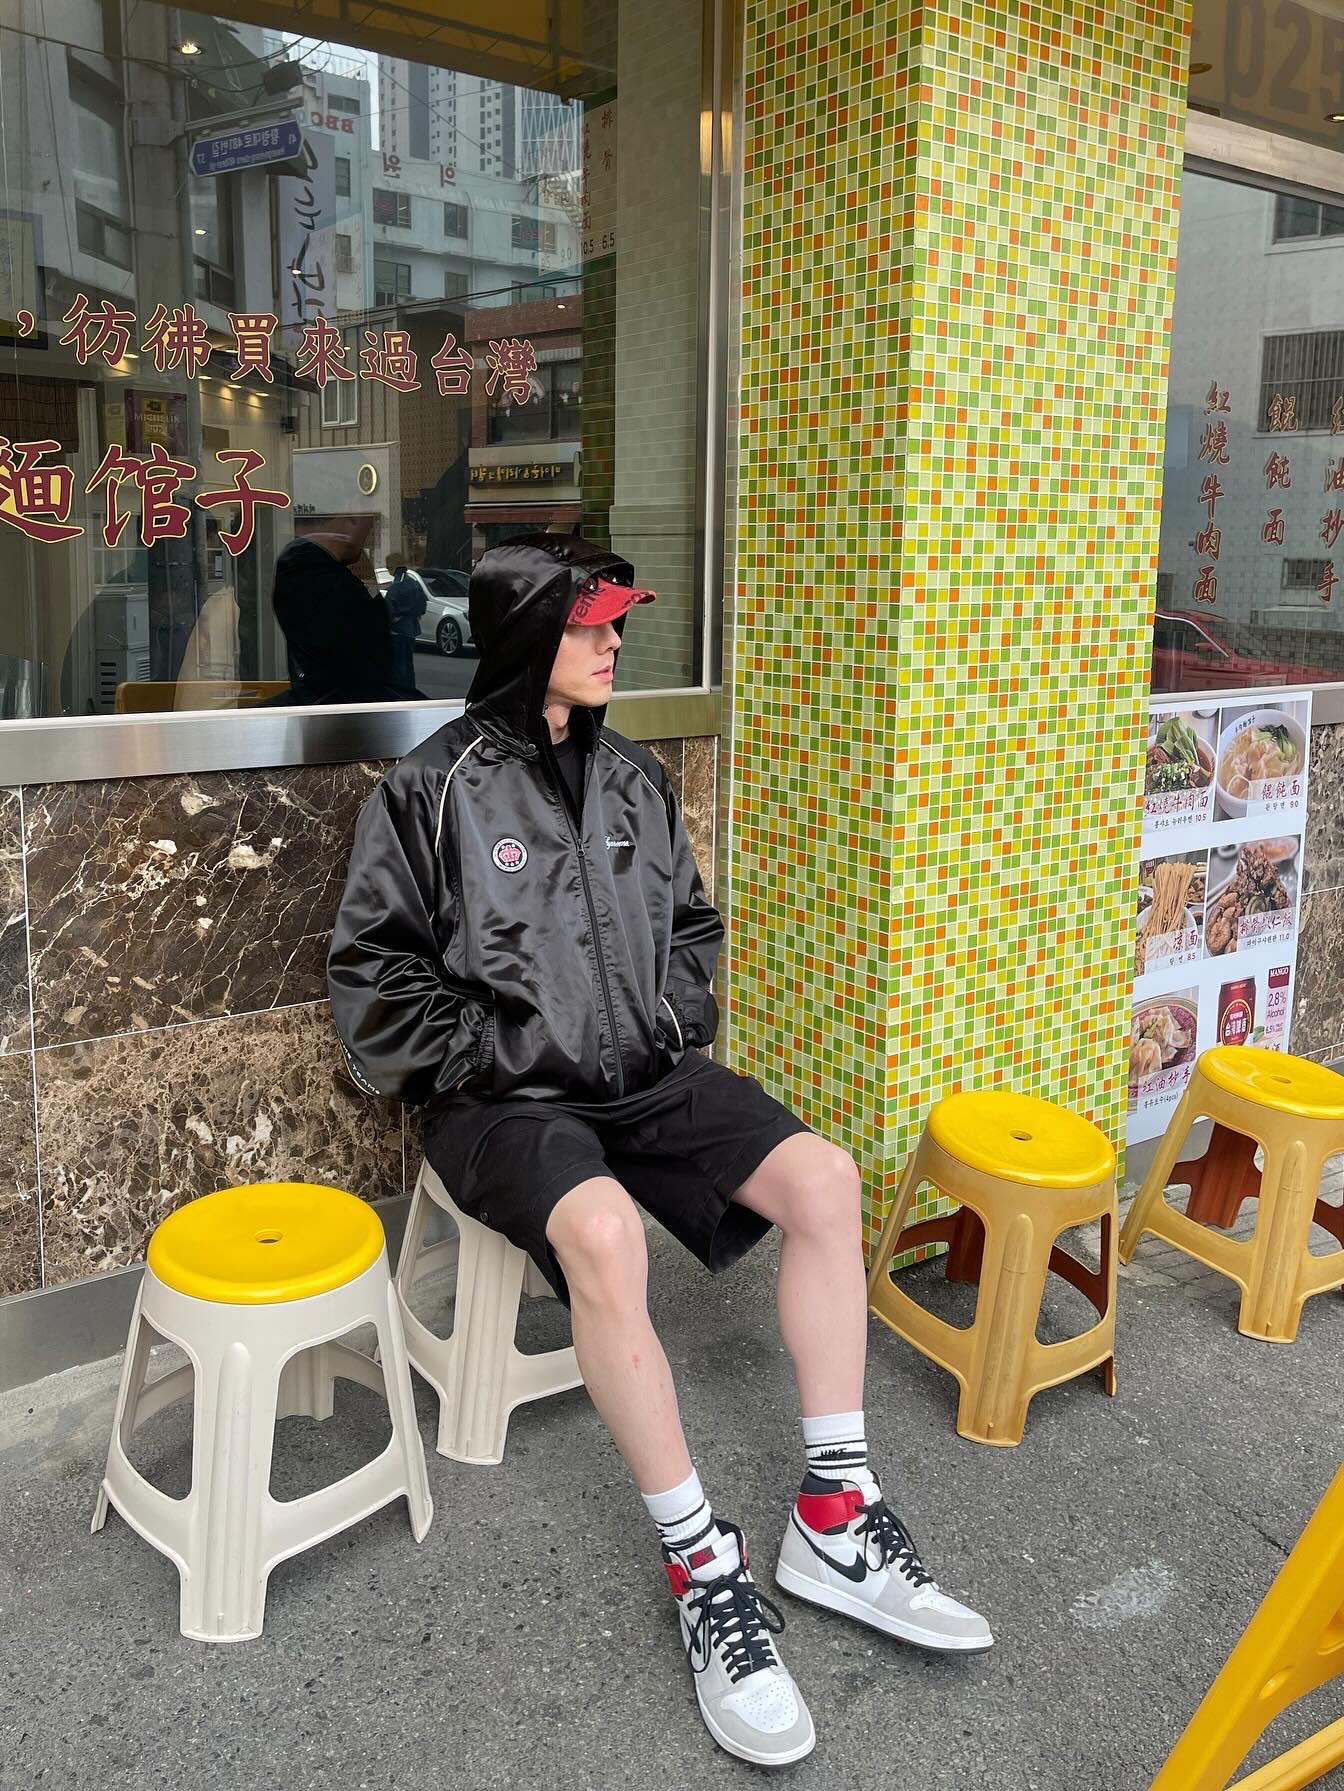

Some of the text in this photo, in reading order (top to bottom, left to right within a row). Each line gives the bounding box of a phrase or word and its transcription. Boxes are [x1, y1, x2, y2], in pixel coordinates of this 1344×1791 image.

[602, 232, 615, 249] 6.5
[1193, 380, 1232, 605] 紅燒牛肉面
[1269, 967, 1289, 977] MANGO
[1268, 991, 1287, 1007] 2.8%
[1267, 1008, 1285, 1018] Alcohol
